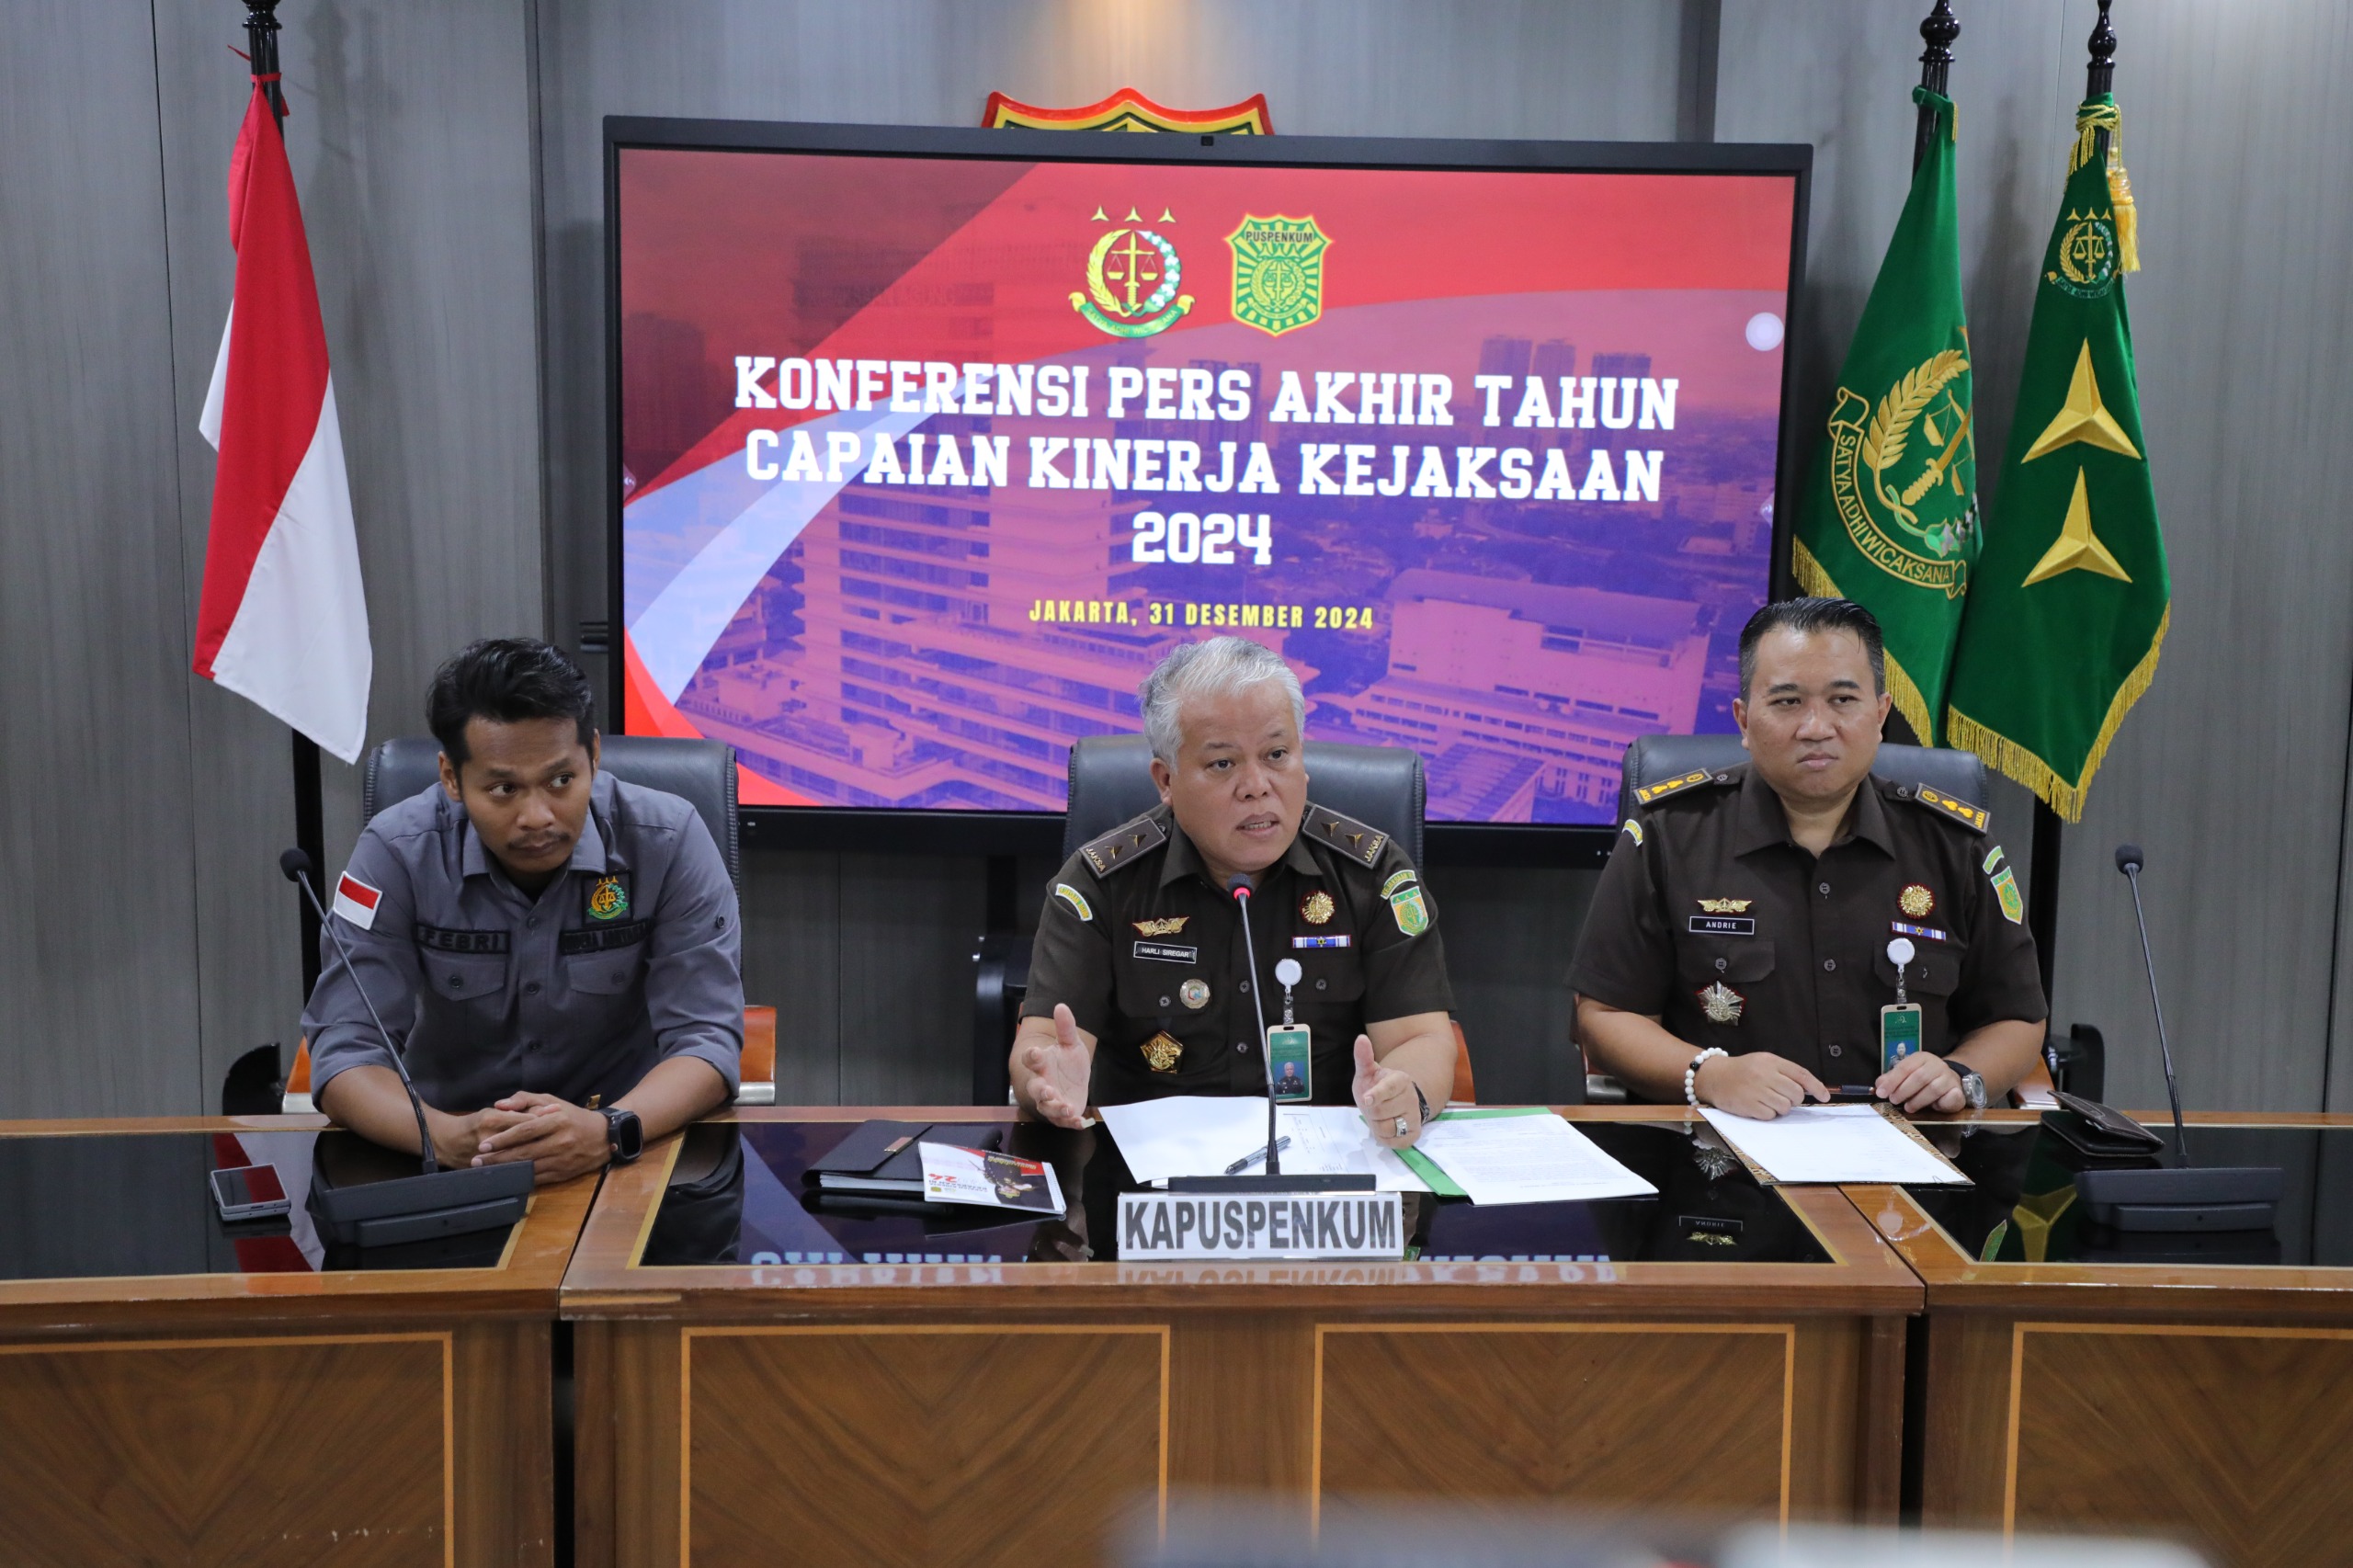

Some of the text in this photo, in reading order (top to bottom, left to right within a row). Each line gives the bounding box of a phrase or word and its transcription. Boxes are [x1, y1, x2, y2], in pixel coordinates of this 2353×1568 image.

[1245, 231, 1313, 243] PUSPENKUM
[734, 355, 1679, 430] KONFERENSI PERS AKHIR TAHUN
[745, 428, 1665, 503] CAPAIAN KINERJA KEJAKSAAN
[1836, 434, 1949, 583] SATYA ADHI WICAKSANA
[1131, 511, 1274, 566] 2024
[1029, 599, 1374, 630] JAKARTA, 31 DESEMBER 2024
[1086, 847, 1108, 872] JAKSA
[1364, 835, 1383, 862] JAKSA
[424, 928, 499, 950] FEBRI
[1705, 921, 1737, 929] ANDRIE
[1142, 947, 1189, 958] HARLI SIREGAR
[1124, 1199, 1397, 1251] KAPUSPENKUM
